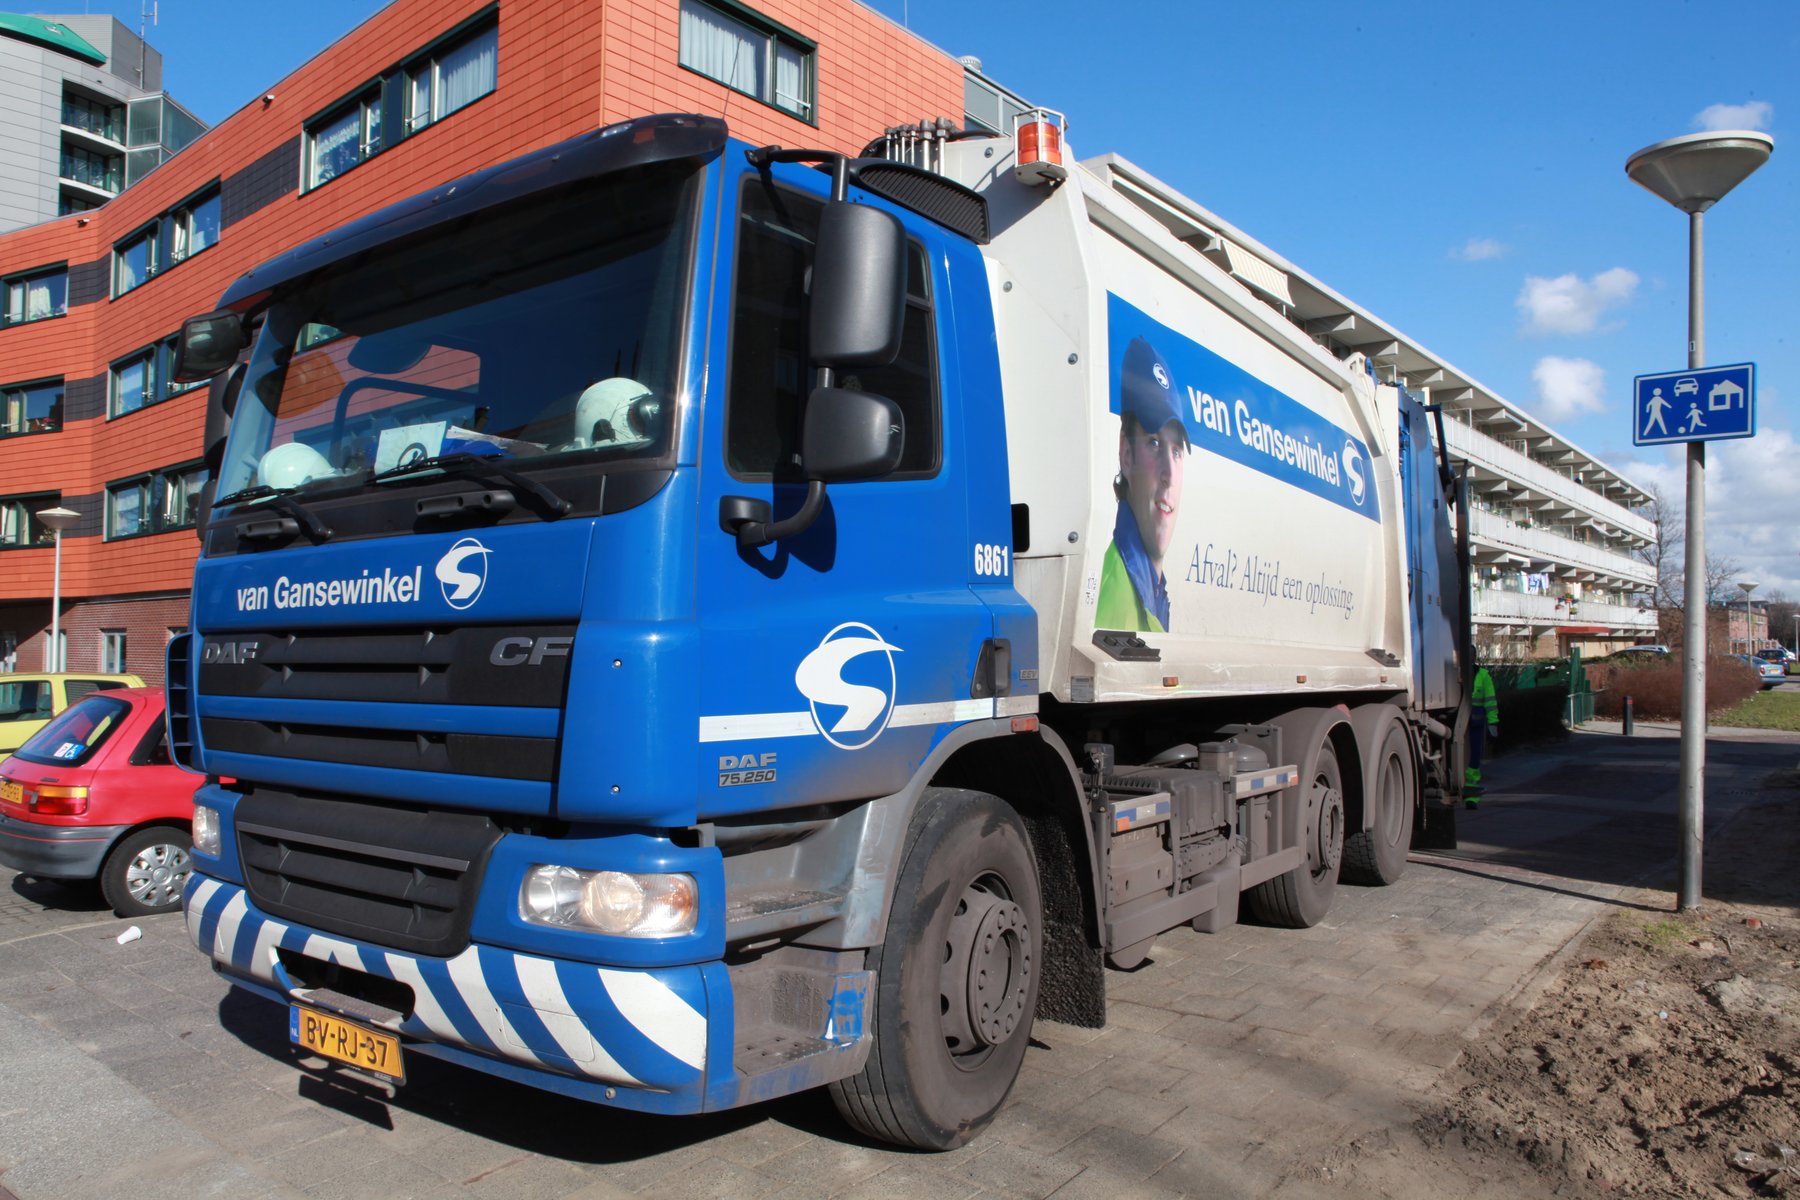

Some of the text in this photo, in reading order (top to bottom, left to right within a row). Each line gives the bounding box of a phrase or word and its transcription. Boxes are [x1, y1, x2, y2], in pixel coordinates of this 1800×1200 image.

[1187, 385, 1340, 487] van Gansewinkel
[974, 543, 1009, 577] 6861
[237, 565, 422, 611] van Gansewinkel
[1185, 543, 1354, 620] Afval? Altijd een oplossing.
[202, 642, 258, 664] DAF
[489, 636, 575, 666] CF
[719, 752, 777, 770] DAF
[720, 769, 776, 786] 75.250
[306, 1016, 389, 1067] BV-RJ-37
